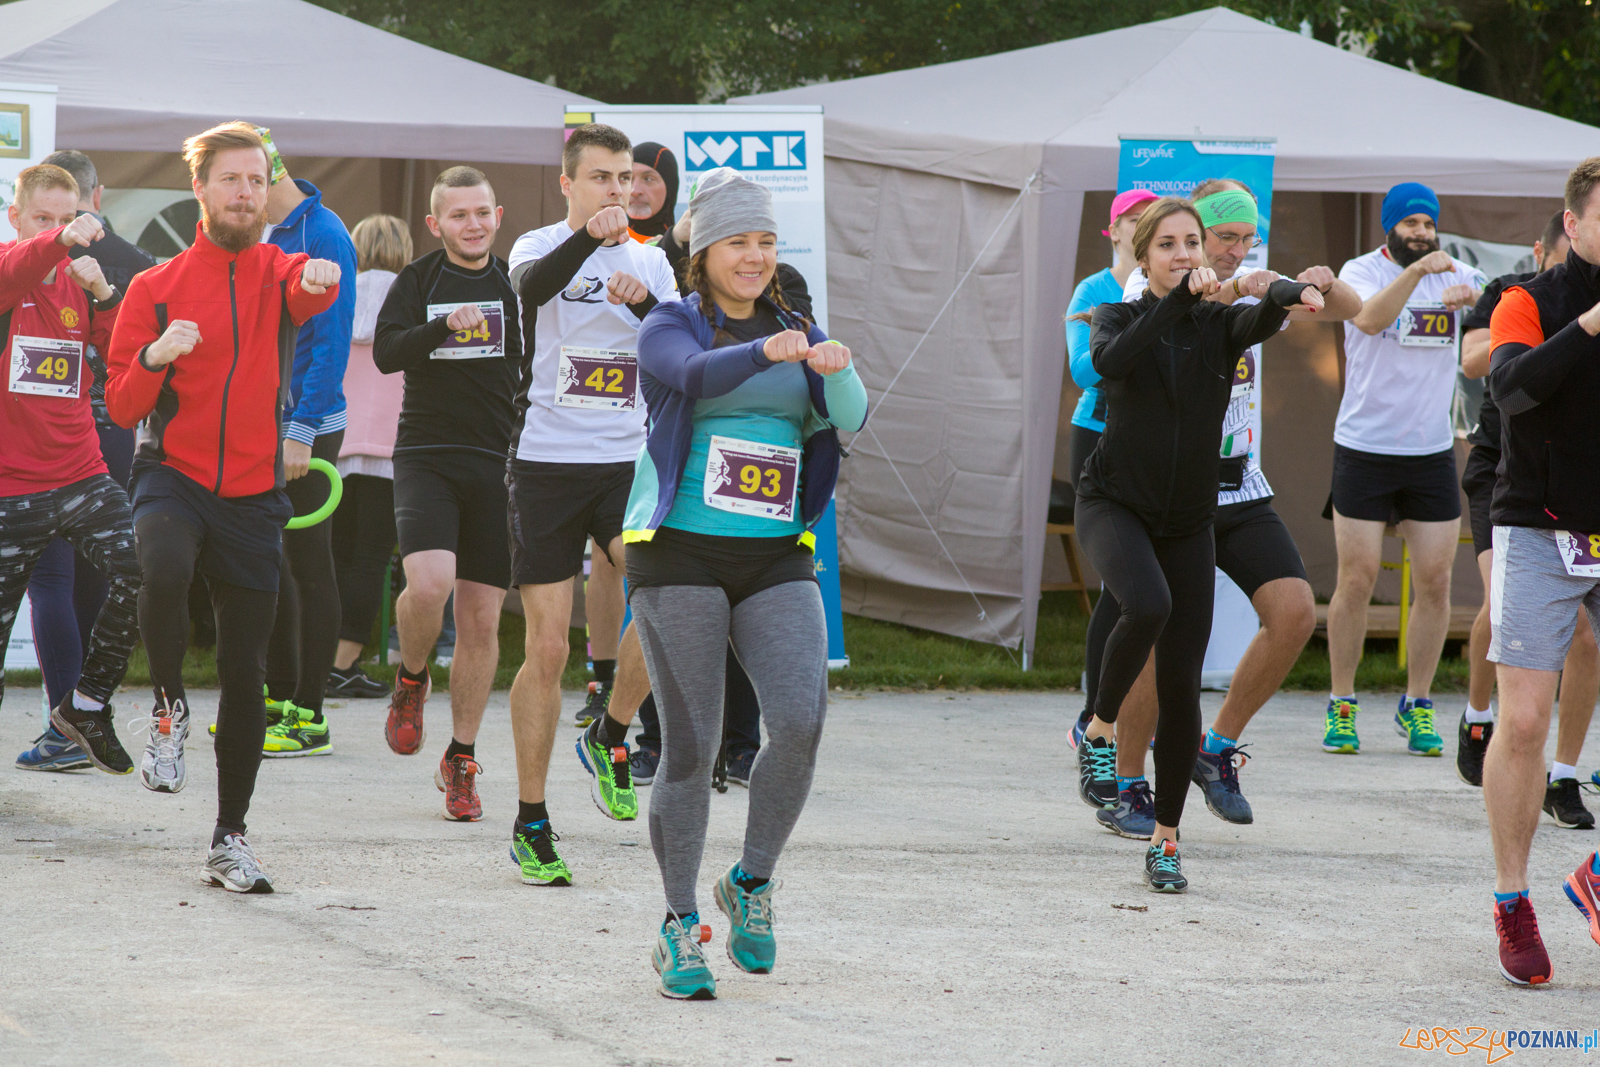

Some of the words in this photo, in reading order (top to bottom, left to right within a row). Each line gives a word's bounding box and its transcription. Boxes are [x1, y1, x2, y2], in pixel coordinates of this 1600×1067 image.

[1422, 314, 1449, 334] 70
[36, 356, 69, 381] 49
[584, 367, 625, 393] 42
[738, 464, 782, 497] 93
